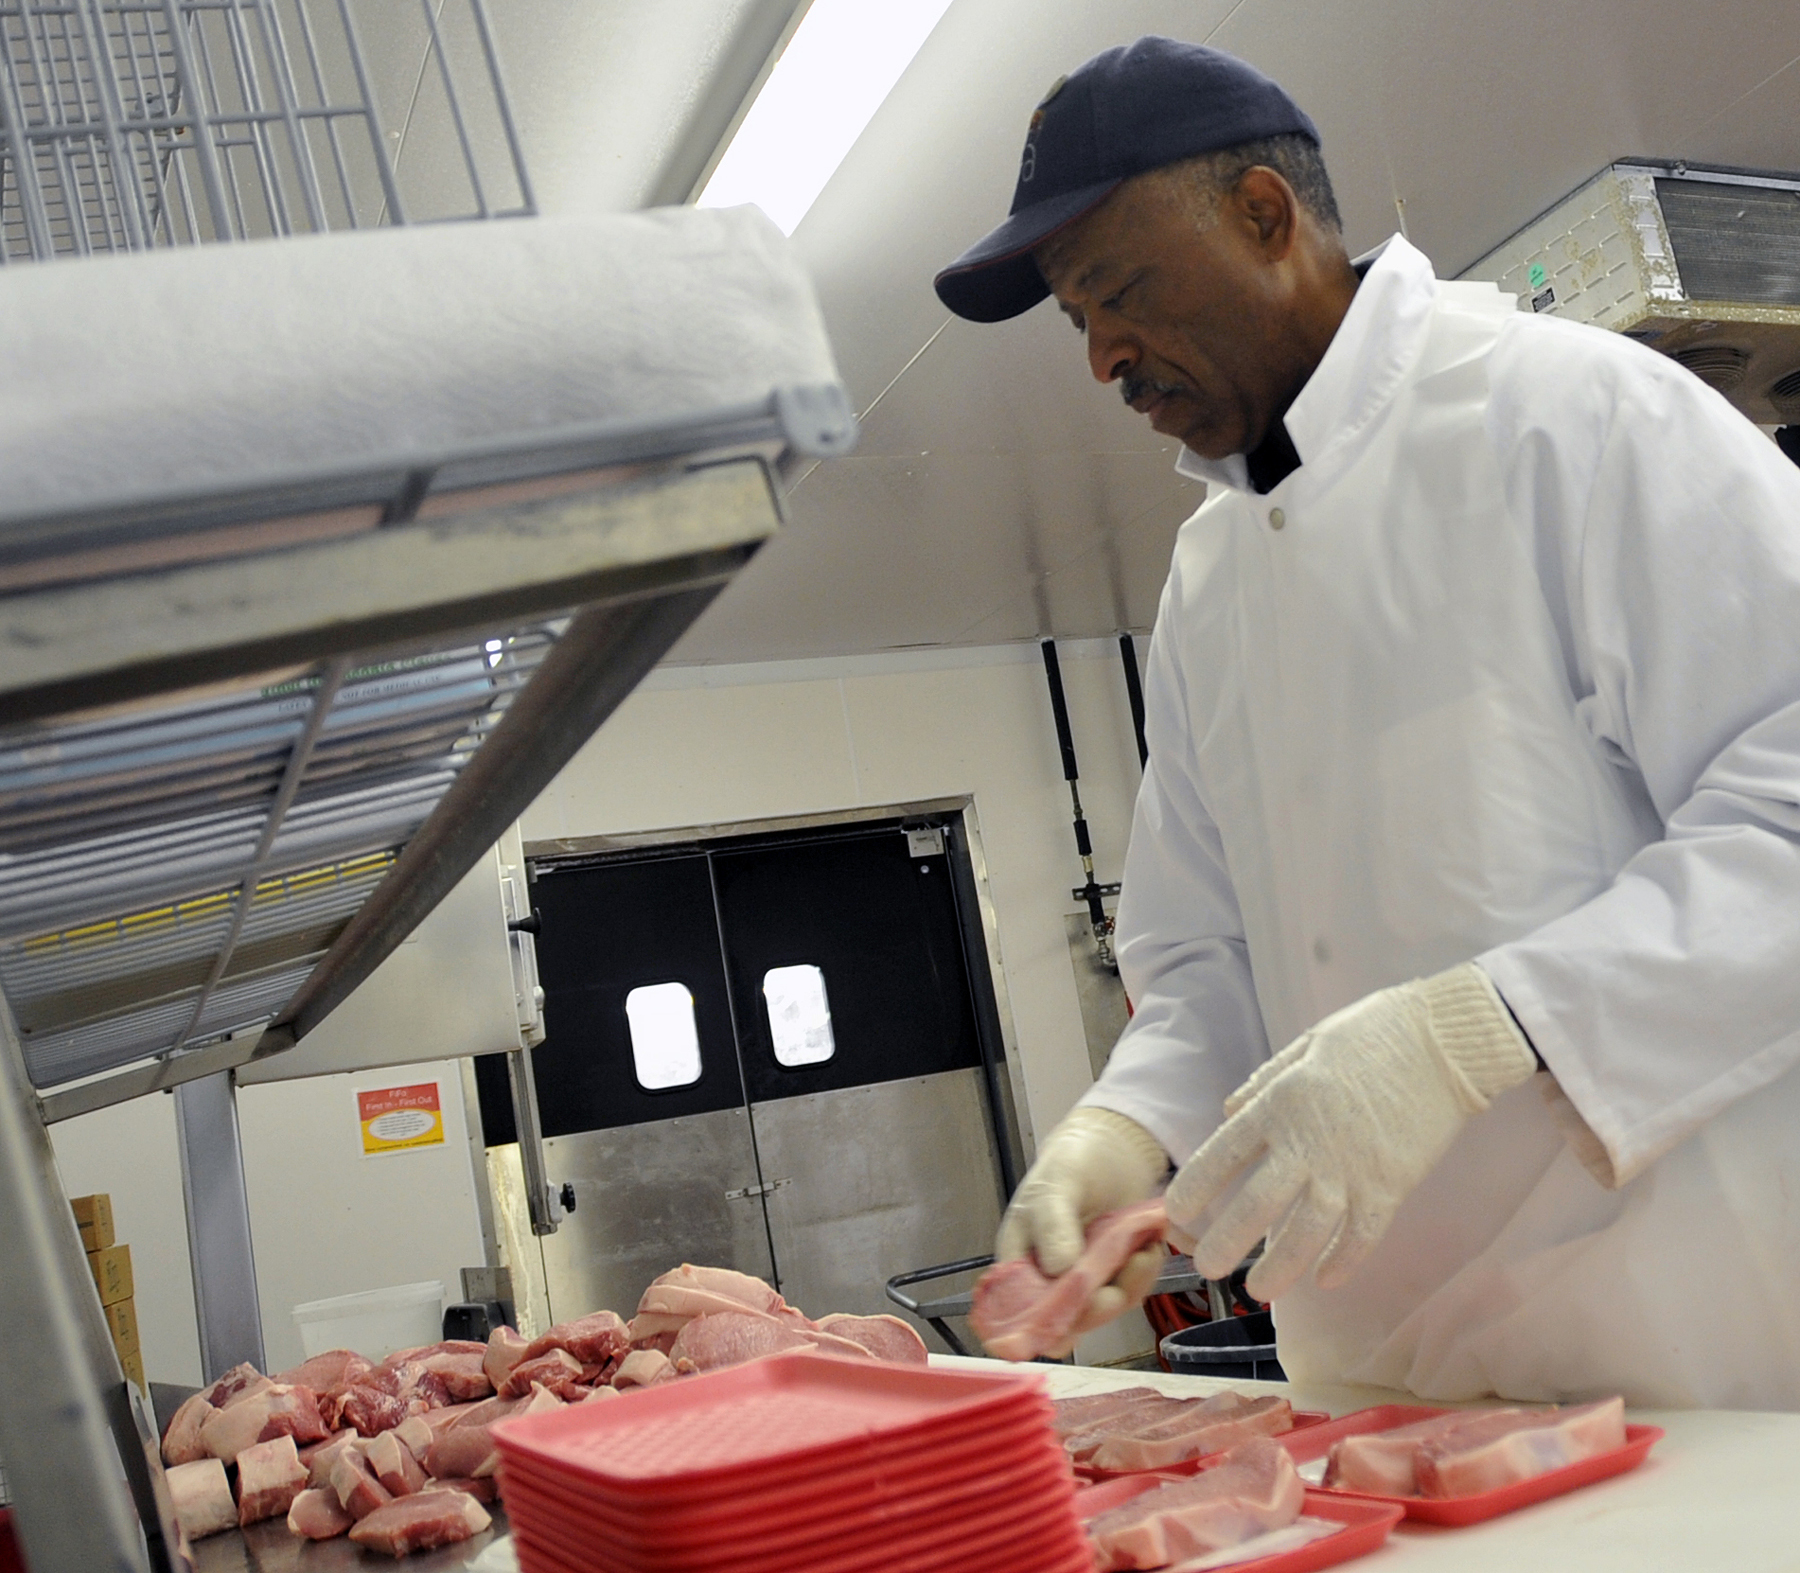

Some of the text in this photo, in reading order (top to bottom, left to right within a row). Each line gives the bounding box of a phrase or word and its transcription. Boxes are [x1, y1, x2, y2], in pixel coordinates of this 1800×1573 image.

[365, 1103, 383, 1111] First
[399, 1098, 416, 1107] First
[418, 1096, 433, 1104] Out
